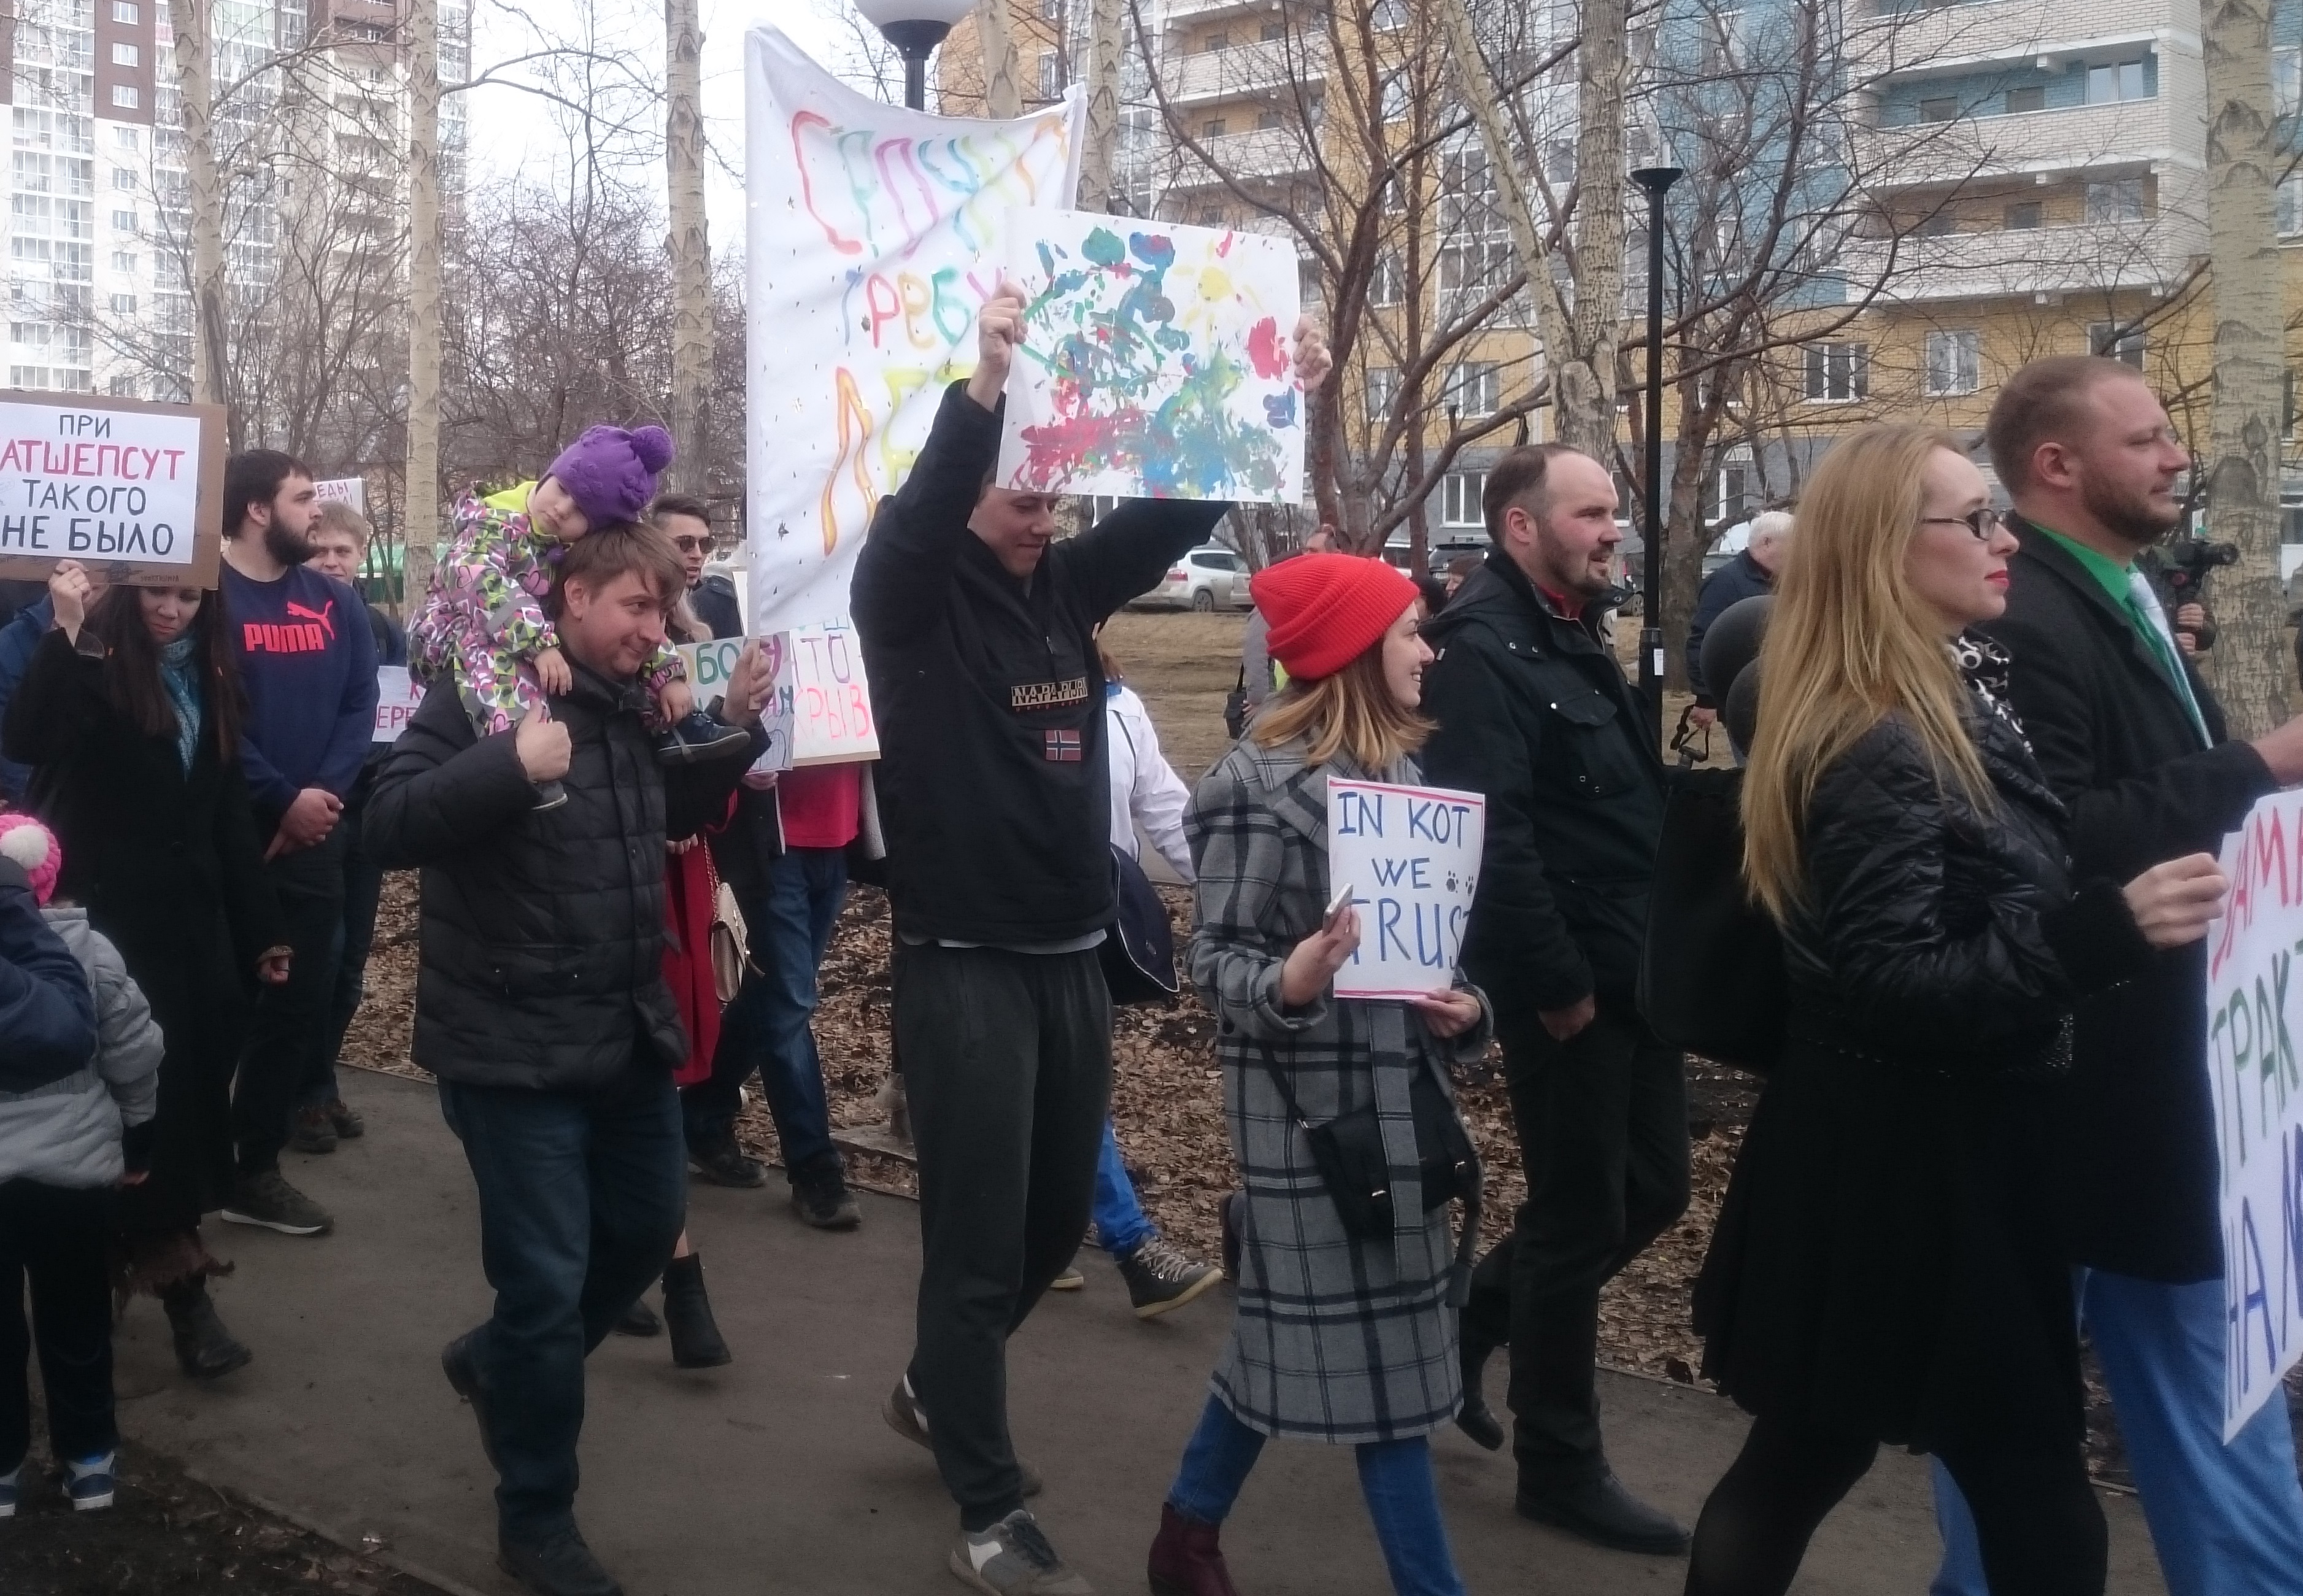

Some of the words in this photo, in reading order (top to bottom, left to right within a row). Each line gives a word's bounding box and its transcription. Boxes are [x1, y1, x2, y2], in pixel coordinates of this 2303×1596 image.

[60, 414, 110, 439] ПРИ
[0, 438, 186, 481] АТШЕПСУТ
[22, 479, 147, 516] ТАКОГО
[2, 515, 50, 549] НЕ
[68, 518, 174, 556] БЫЛО
[244, 623, 325, 653] PUMA
[1337, 791, 1383, 839] IN
[1408, 798, 1470, 849] KOT
[1371, 857, 1432, 889] WE
[1351, 898, 1471, 970] RUS
[2211, 940, 2303, 1198] ТРАК
